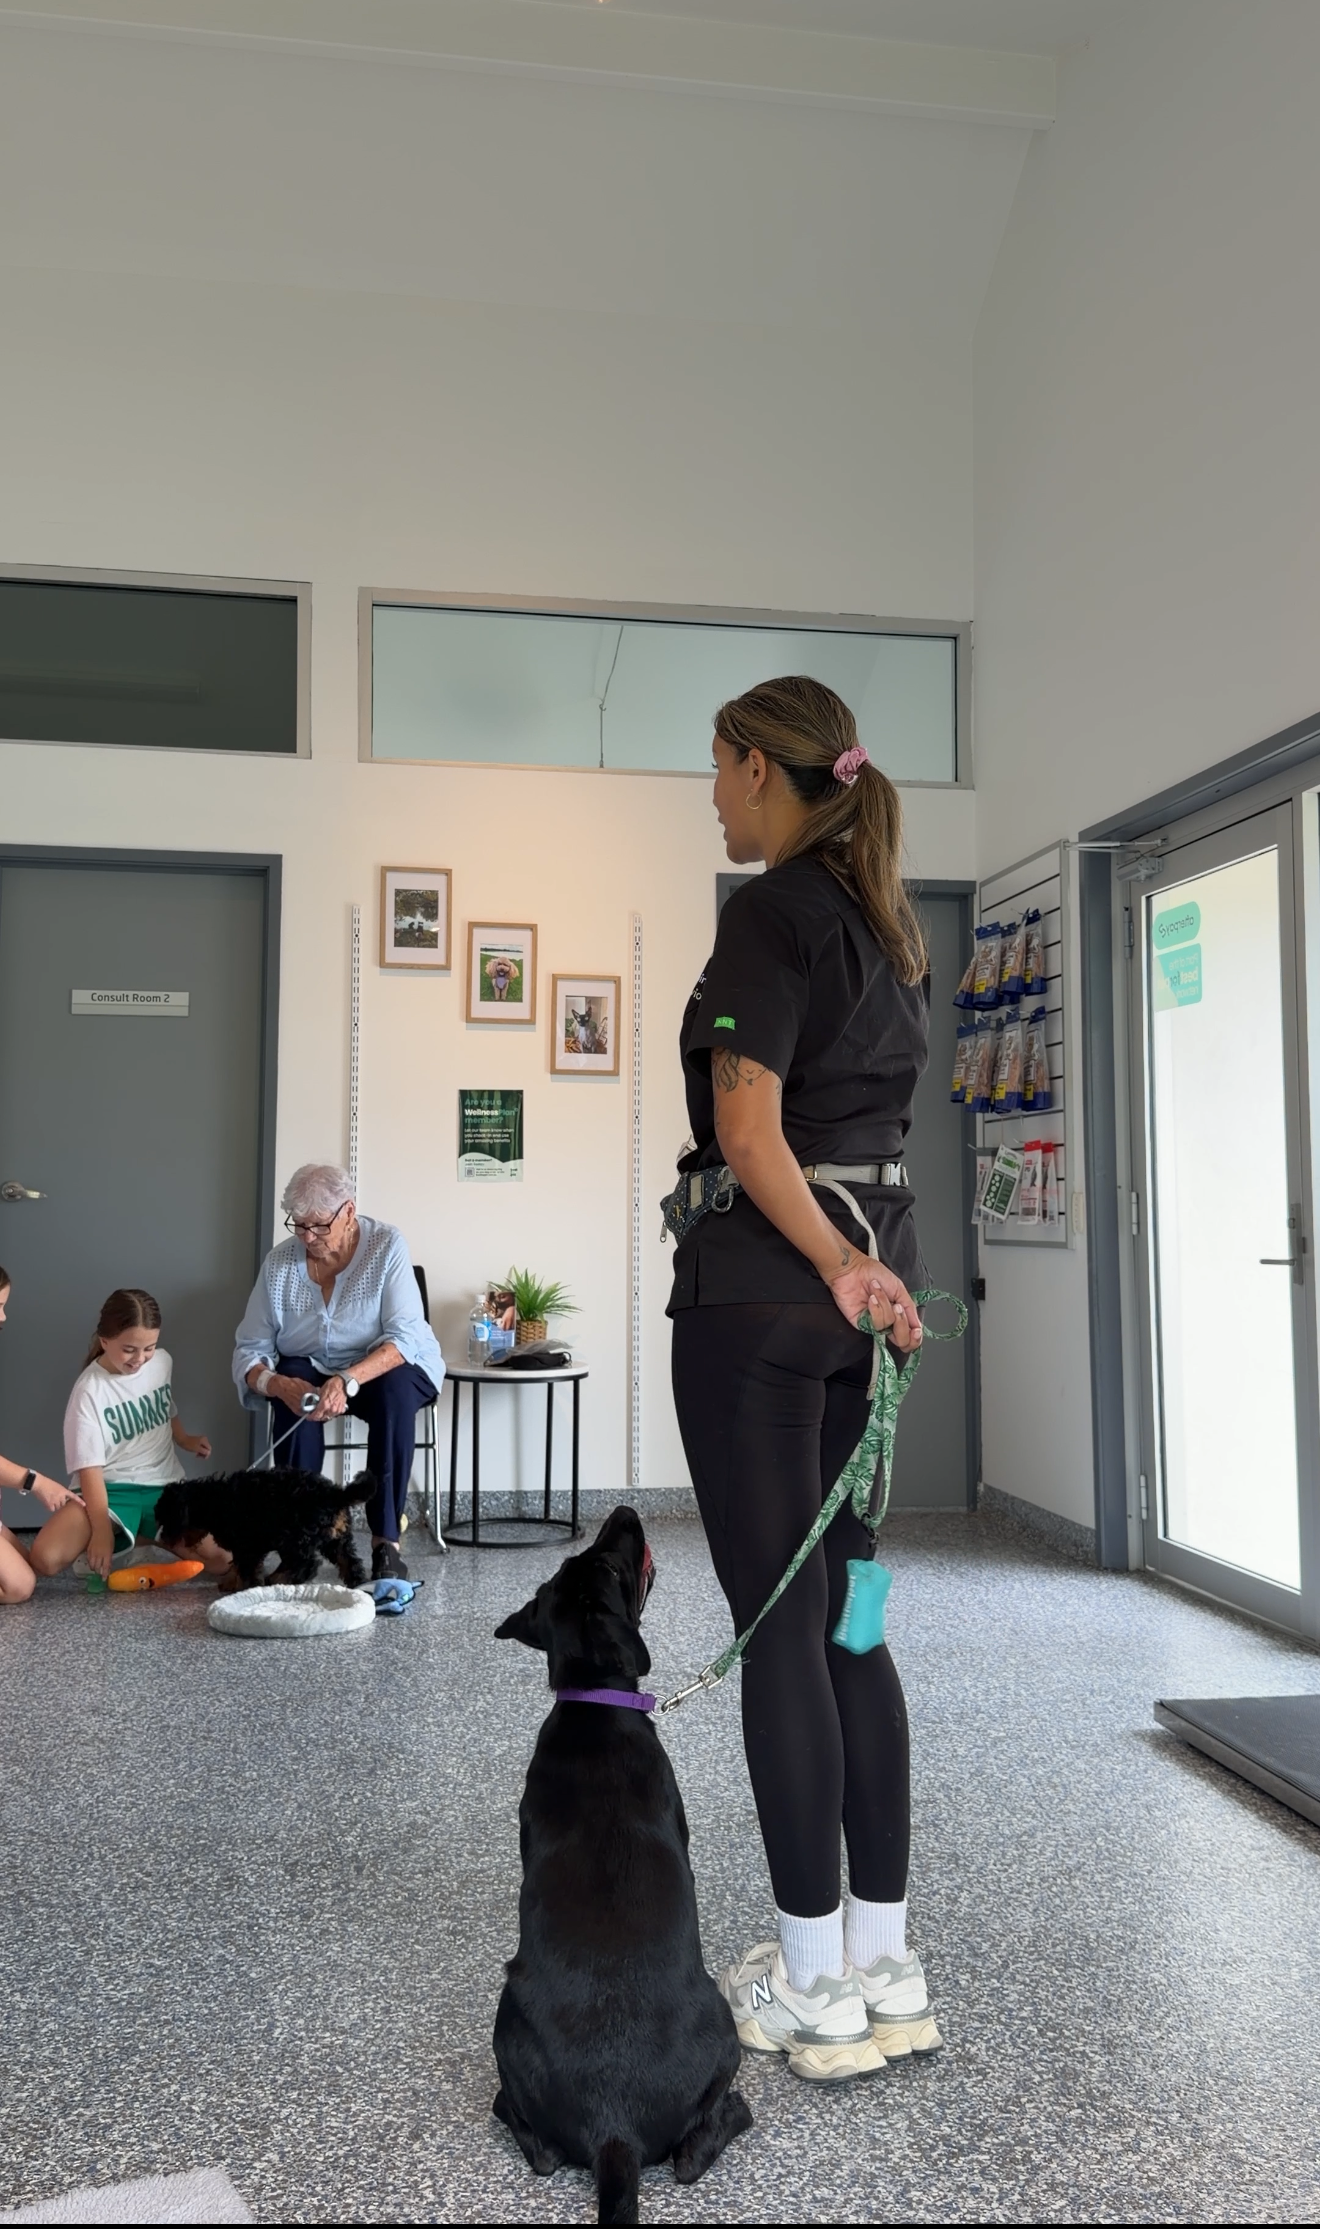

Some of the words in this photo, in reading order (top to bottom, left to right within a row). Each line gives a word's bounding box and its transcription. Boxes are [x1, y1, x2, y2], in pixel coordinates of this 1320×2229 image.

[91, 992, 130, 1003] Consult
[132, 993, 162, 1003] Room
[163, 993, 170, 1003] 2
[480, 1099, 495, 1108] you
[465, 1116, 504, 1124] member?
[750, 1973, 774, 2010] N
